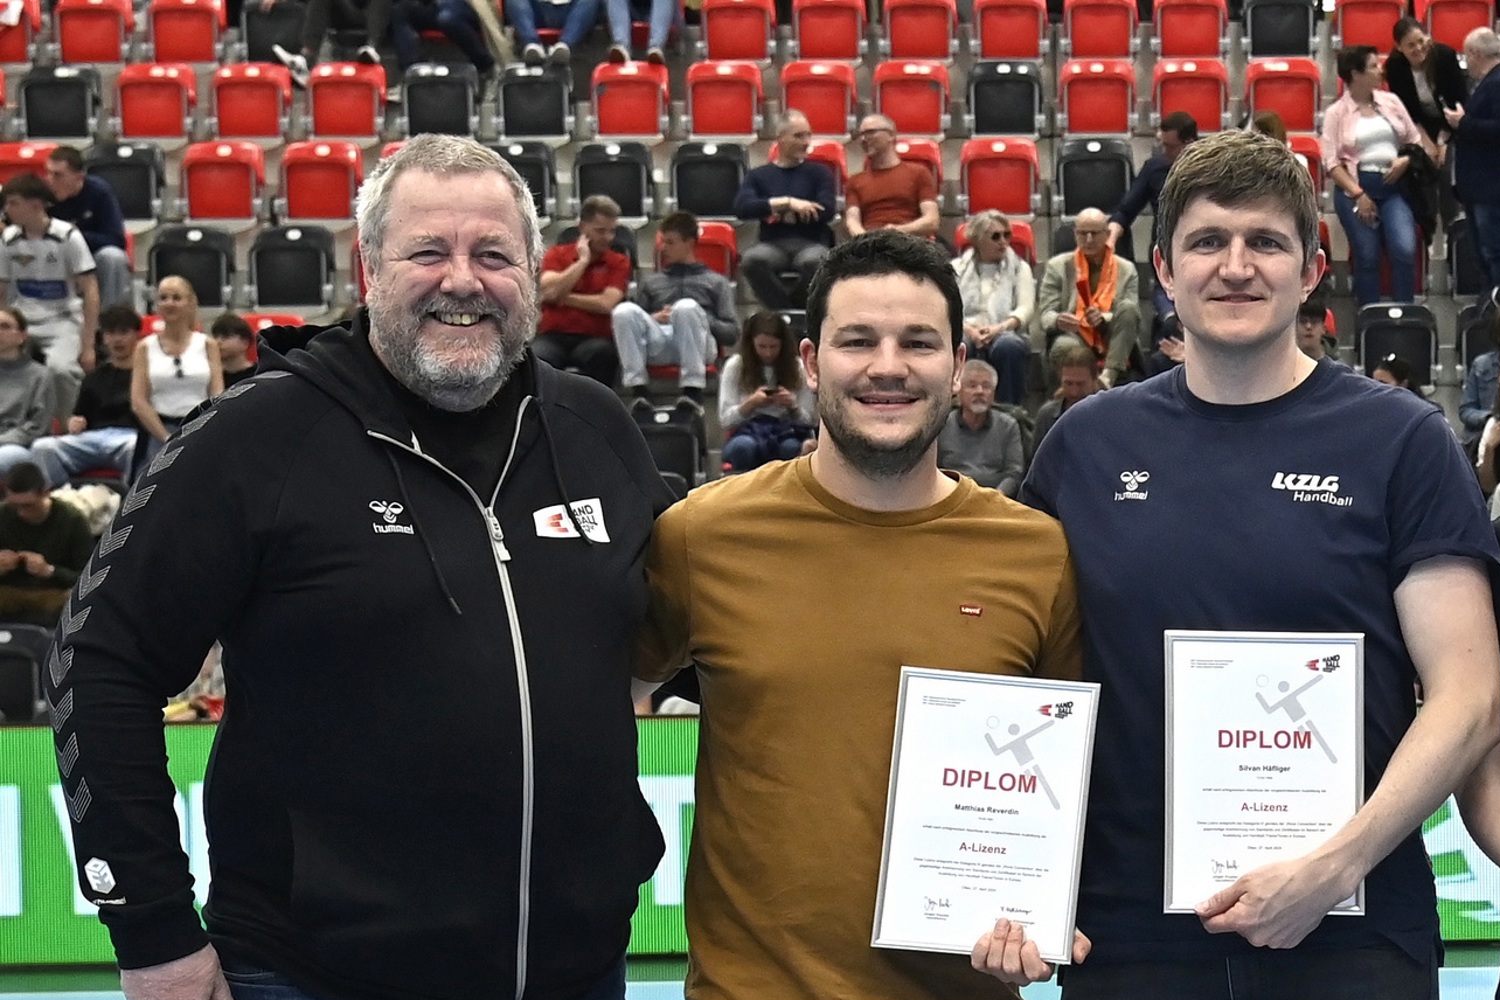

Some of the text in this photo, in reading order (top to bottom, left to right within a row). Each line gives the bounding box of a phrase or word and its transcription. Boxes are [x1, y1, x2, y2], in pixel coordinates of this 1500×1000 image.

[1114, 490, 1149, 501] hummel
[1293, 490, 1353, 507] Handball
[572, 504, 594, 517] AND
[372, 522, 415, 535] hummel
[1218, 729, 1312, 749] DIPLOM
[1238, 764, 1291, 773] Silvan Häfliger
[942, 768, 1038, 795] DIPLOM
[954, 803, 1020, 816] Matthias Reverdin
[1240, 801, 1289, 813] A-Lizenz
[959, 841, 1007, 856] A-Lizenz
